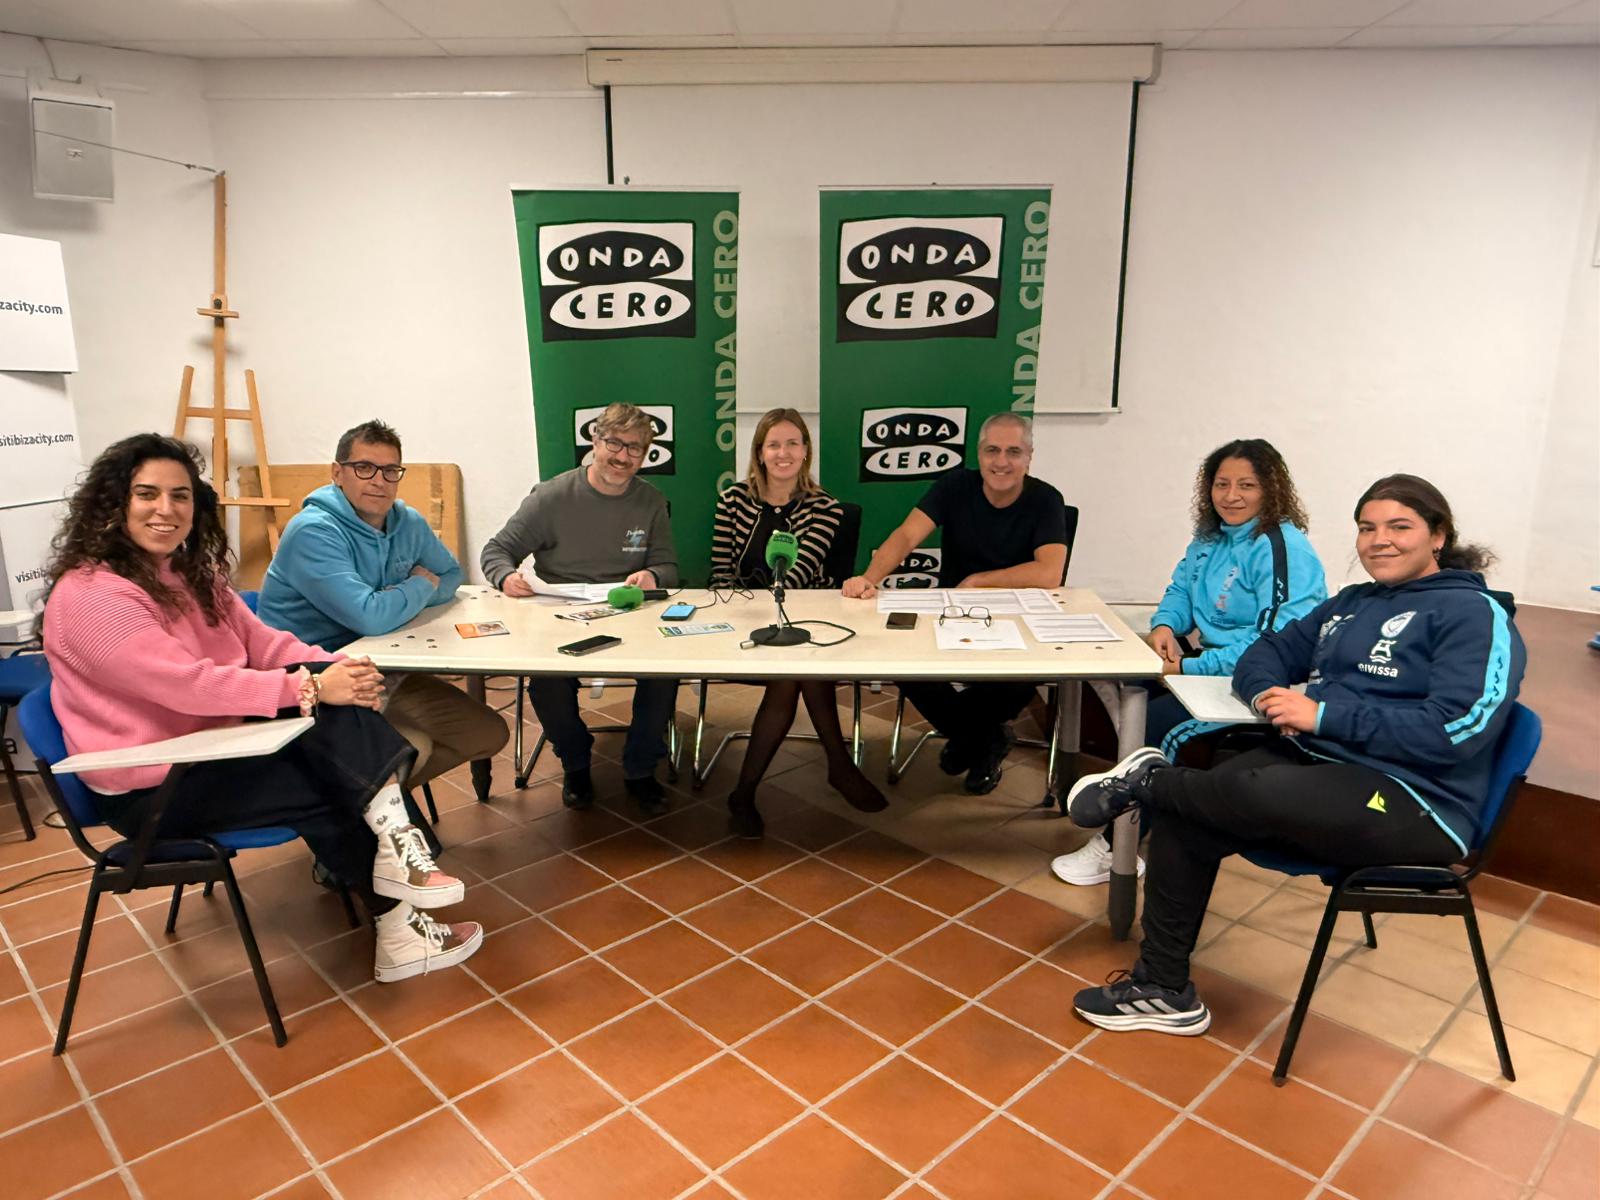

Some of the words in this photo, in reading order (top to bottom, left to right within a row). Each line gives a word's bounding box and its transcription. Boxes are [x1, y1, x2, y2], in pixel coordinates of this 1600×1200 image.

[559, 246, 671, 272] ONDA
[712, 209, 739, 319] CERO
[860, 243, 977, 270] ONDA
[1018, 200, 1051, 310] CERO
[569, 292, 672, 319] CERO
[866, 290, 975, 319] CERO
[1010, 324, 1042, 422] NDA
[714, 330, 737, 451] ONDA
[875, 423, 951, 439] ONDA
[878, 452, 950, 469] CERO
